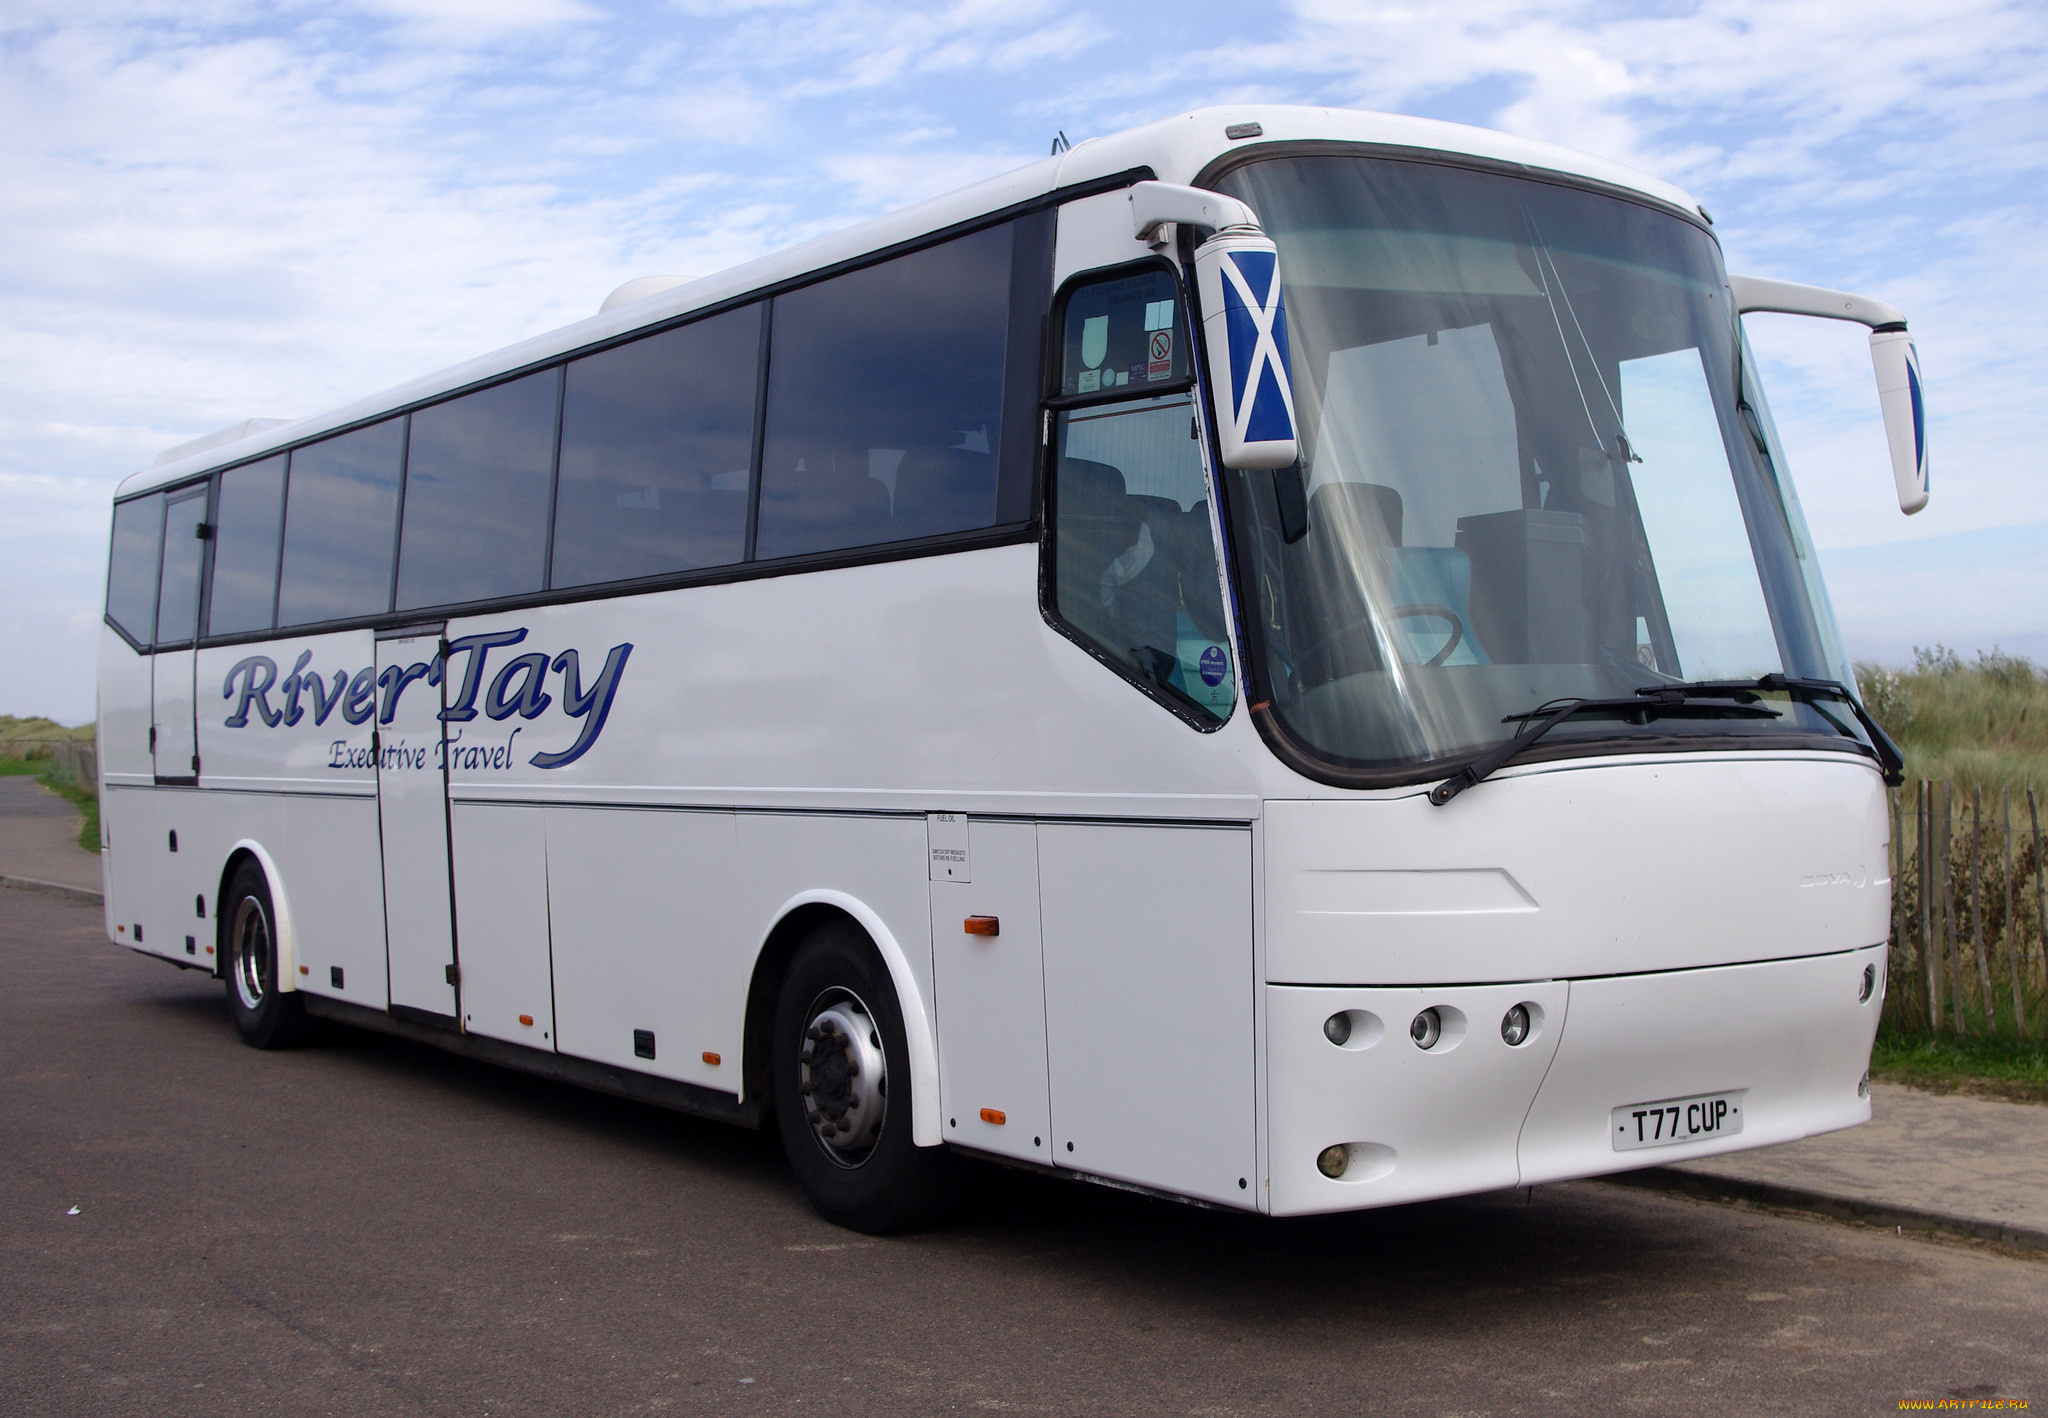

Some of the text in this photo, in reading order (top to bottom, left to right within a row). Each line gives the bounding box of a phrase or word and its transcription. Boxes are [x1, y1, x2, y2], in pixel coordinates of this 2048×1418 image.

[223, 627, 634, 769] River Tay
[328, 727, 522, 770] Executive Travel
[1632, 1100, 1727, 1142] T77 CUP
